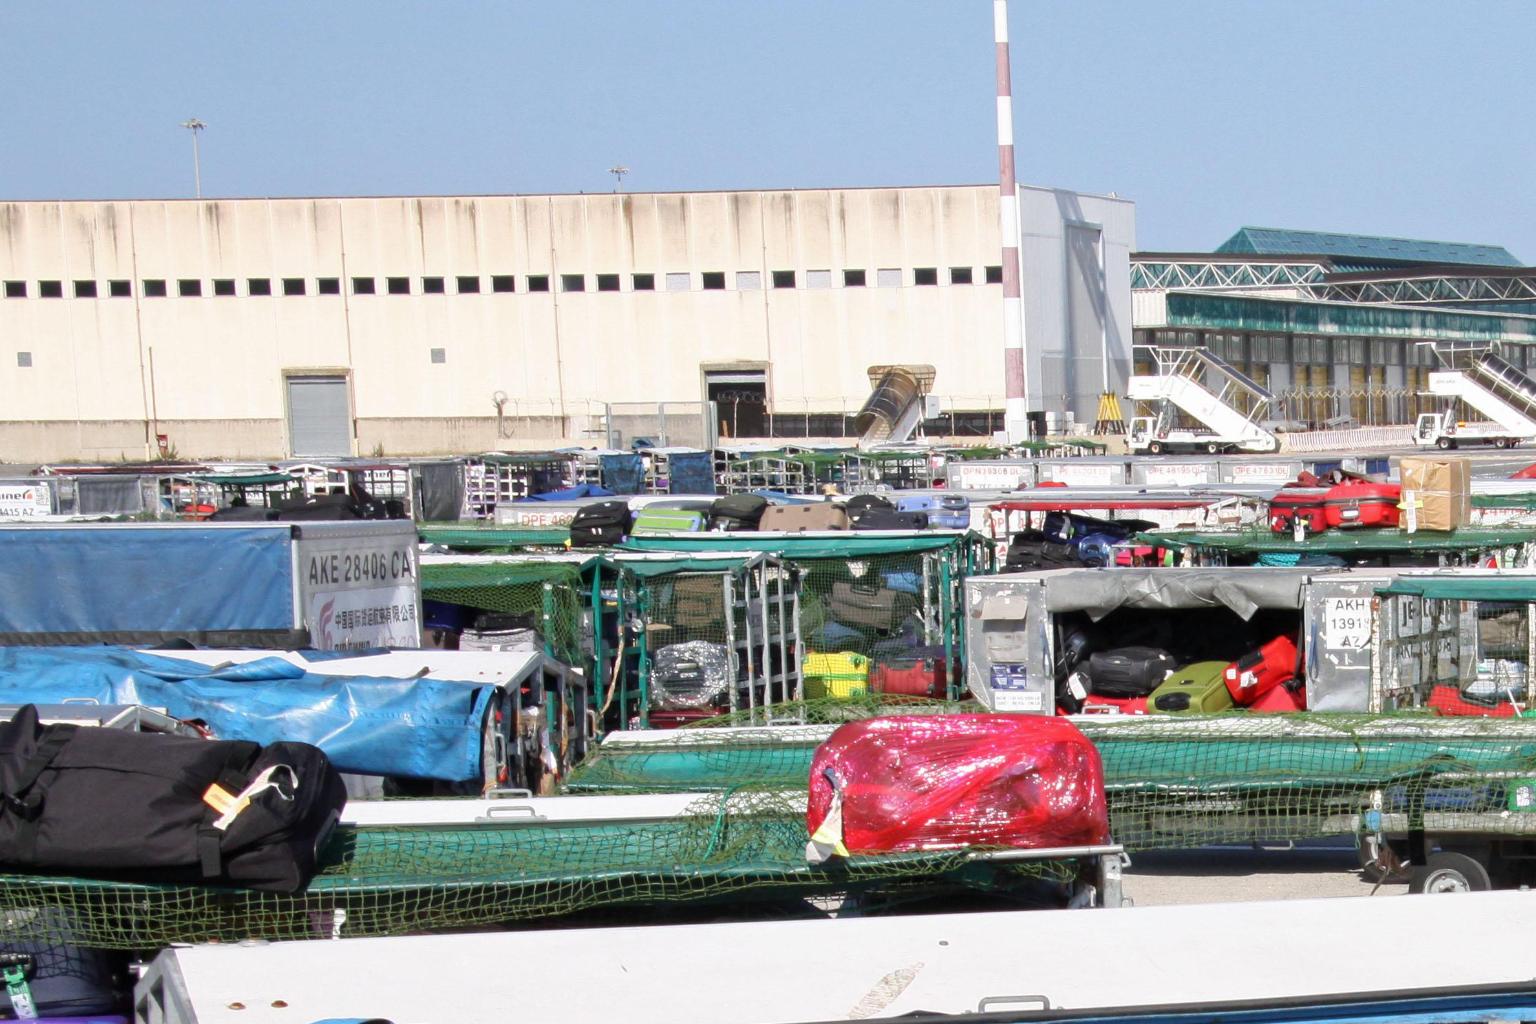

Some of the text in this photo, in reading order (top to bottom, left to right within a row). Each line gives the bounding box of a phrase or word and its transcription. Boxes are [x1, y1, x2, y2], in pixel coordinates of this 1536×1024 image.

[309, 550, 412, 585] AKE 28406 CA
[1335, 599, 1365, 611] AKH
[1342, 636, 1361, 648] AZ
